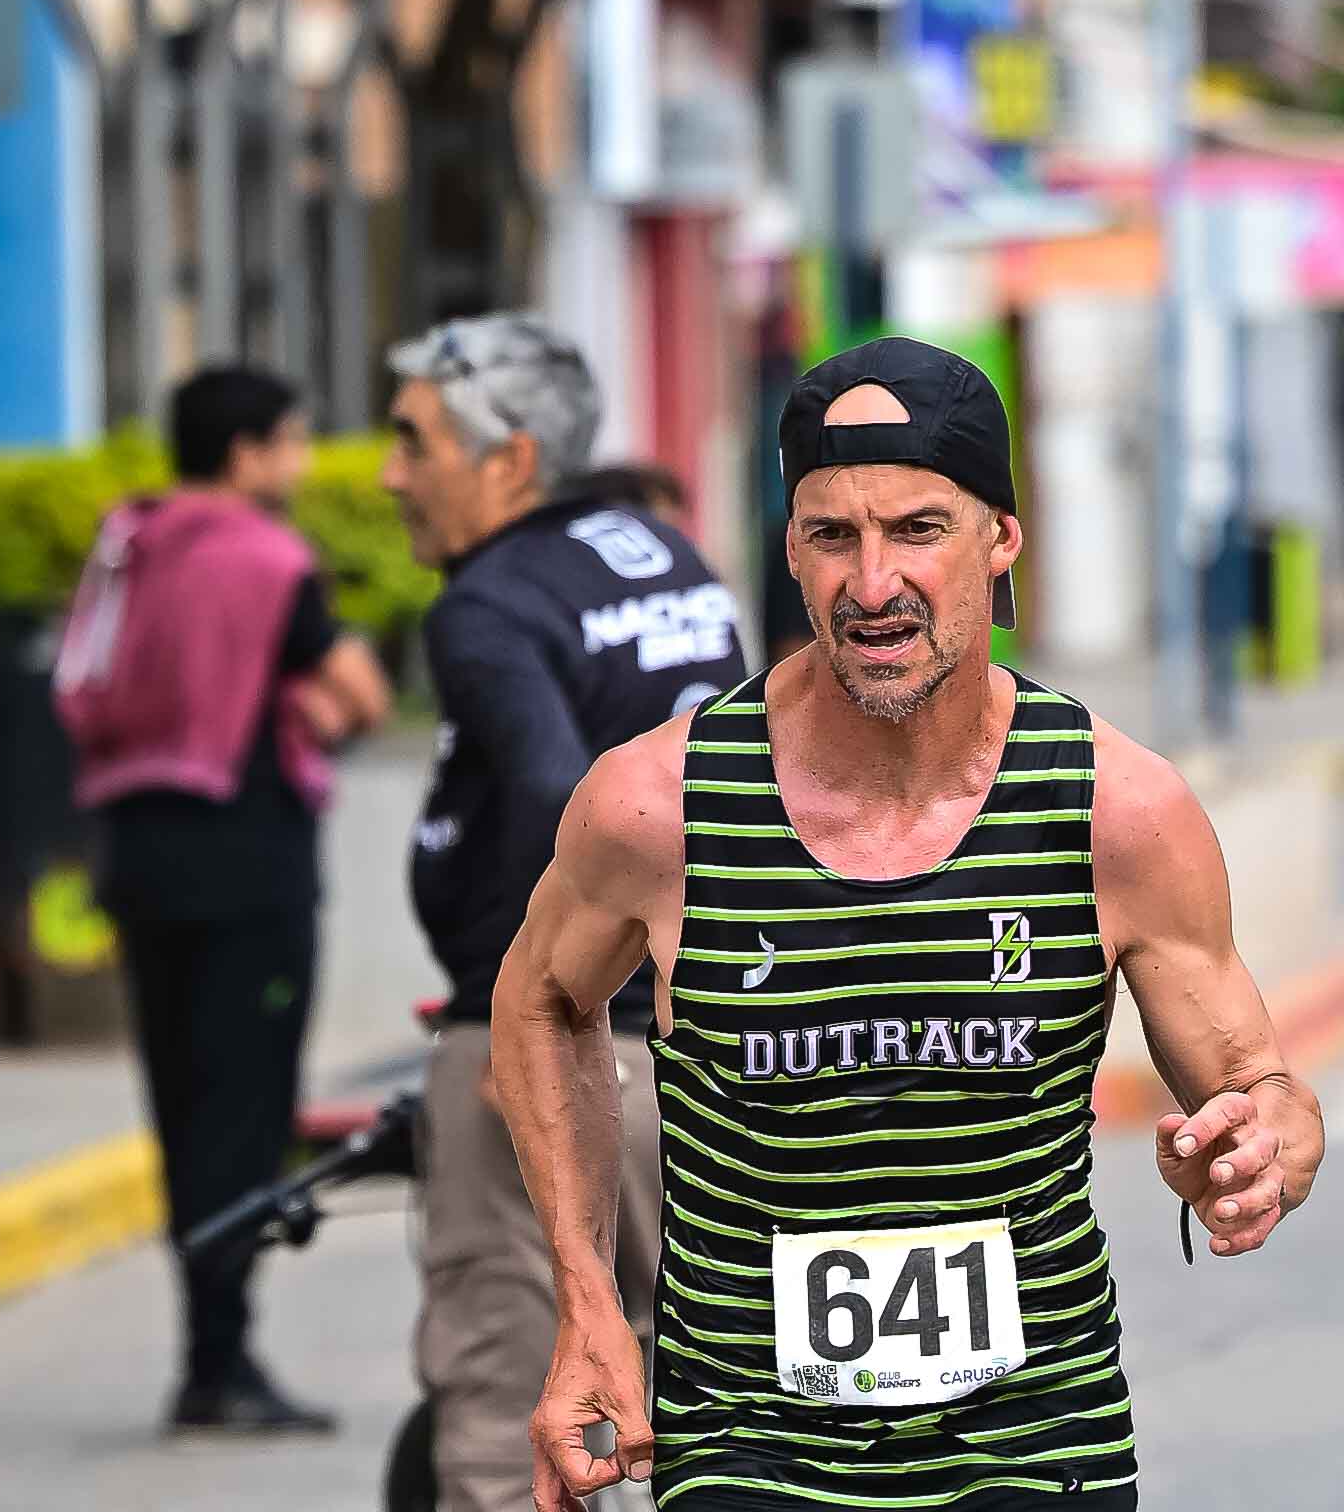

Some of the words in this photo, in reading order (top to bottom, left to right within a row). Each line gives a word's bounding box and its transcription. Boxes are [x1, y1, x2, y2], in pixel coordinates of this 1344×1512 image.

[744, 1017, 1038, 1077] DUTRACK
[806, 1241, 991, 1362] 641
[877, 1371, 901, 1380] CLUB
[940, 1366, 1007, 1385] CARUSO
